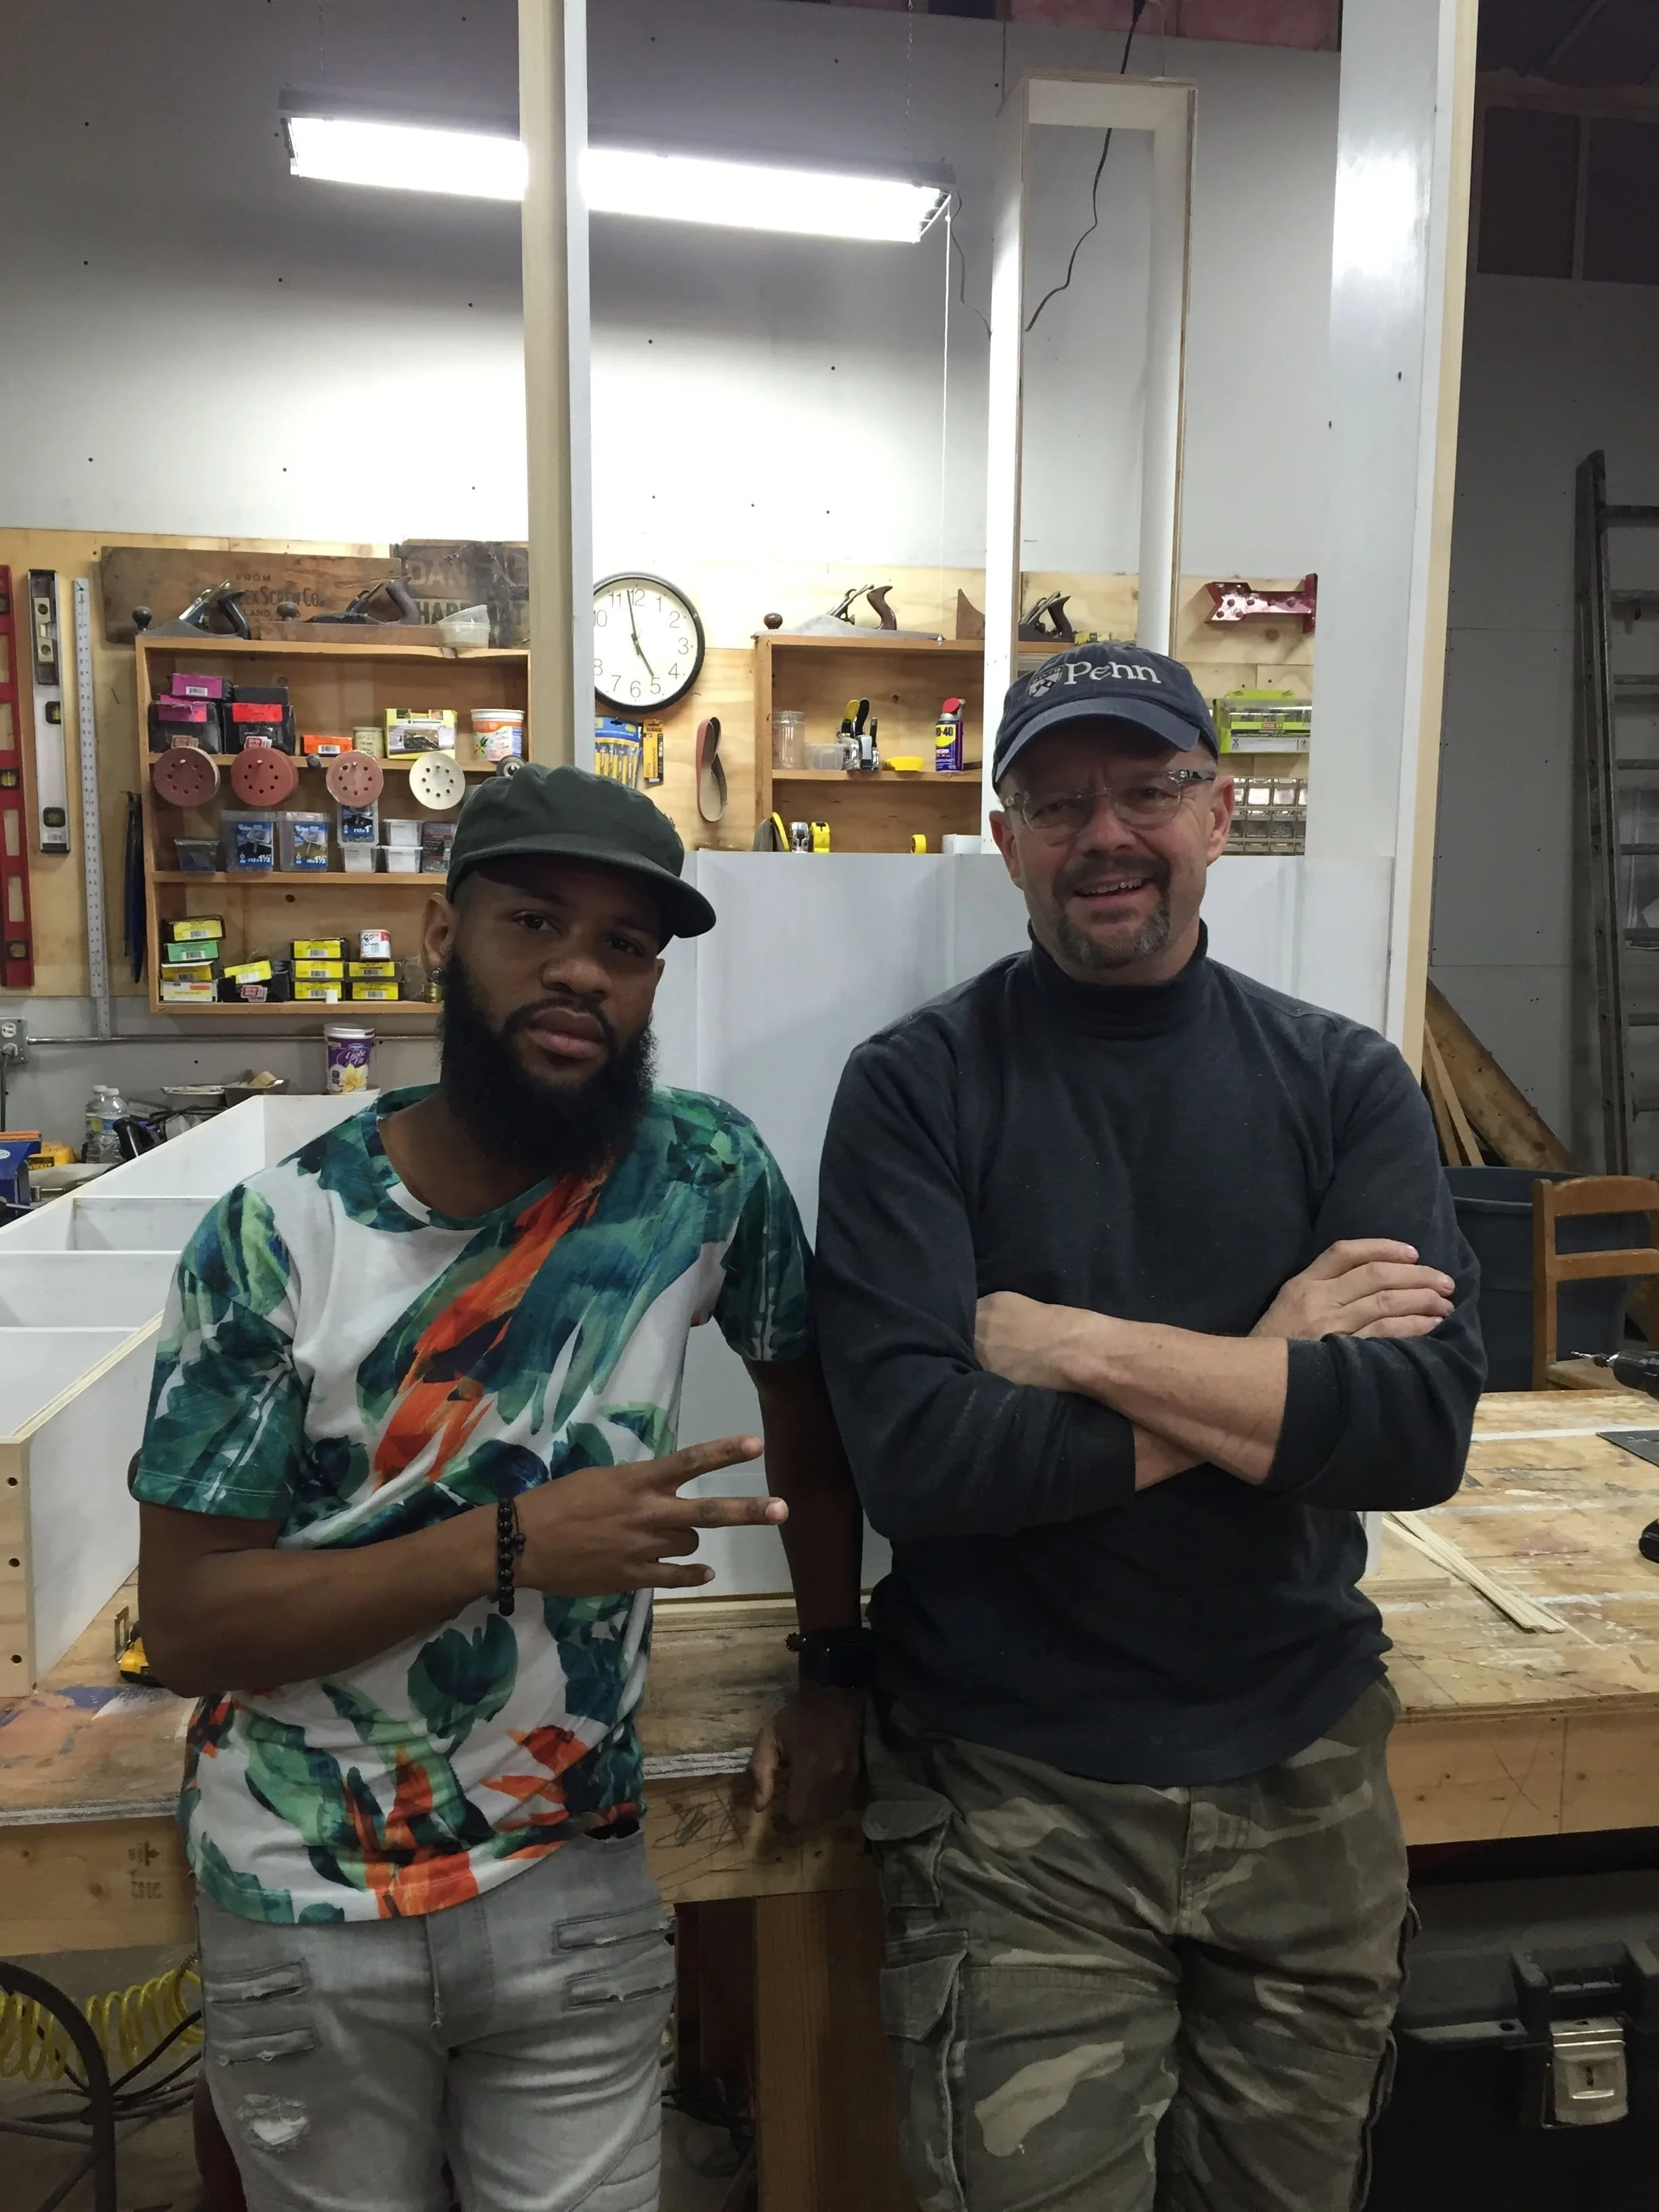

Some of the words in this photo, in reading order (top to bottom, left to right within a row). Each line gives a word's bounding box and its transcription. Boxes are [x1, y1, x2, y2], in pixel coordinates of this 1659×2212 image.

[609, 592, 621, 609] 11
[630, 589, 645, 606] 12
[656, 596, 661, 613] 1
[669, 611, 680, 628] 2
[678, 637, 689, 655] 3
[668, 662, 680, 680] 4
[1063, 661, 1162, 685] Penn
[611, 675, 621, 692] 7
[630, 680, 641, 698] 6
[651, 678, 661, 695] 5
[936, 726, 954, 737] D-40
